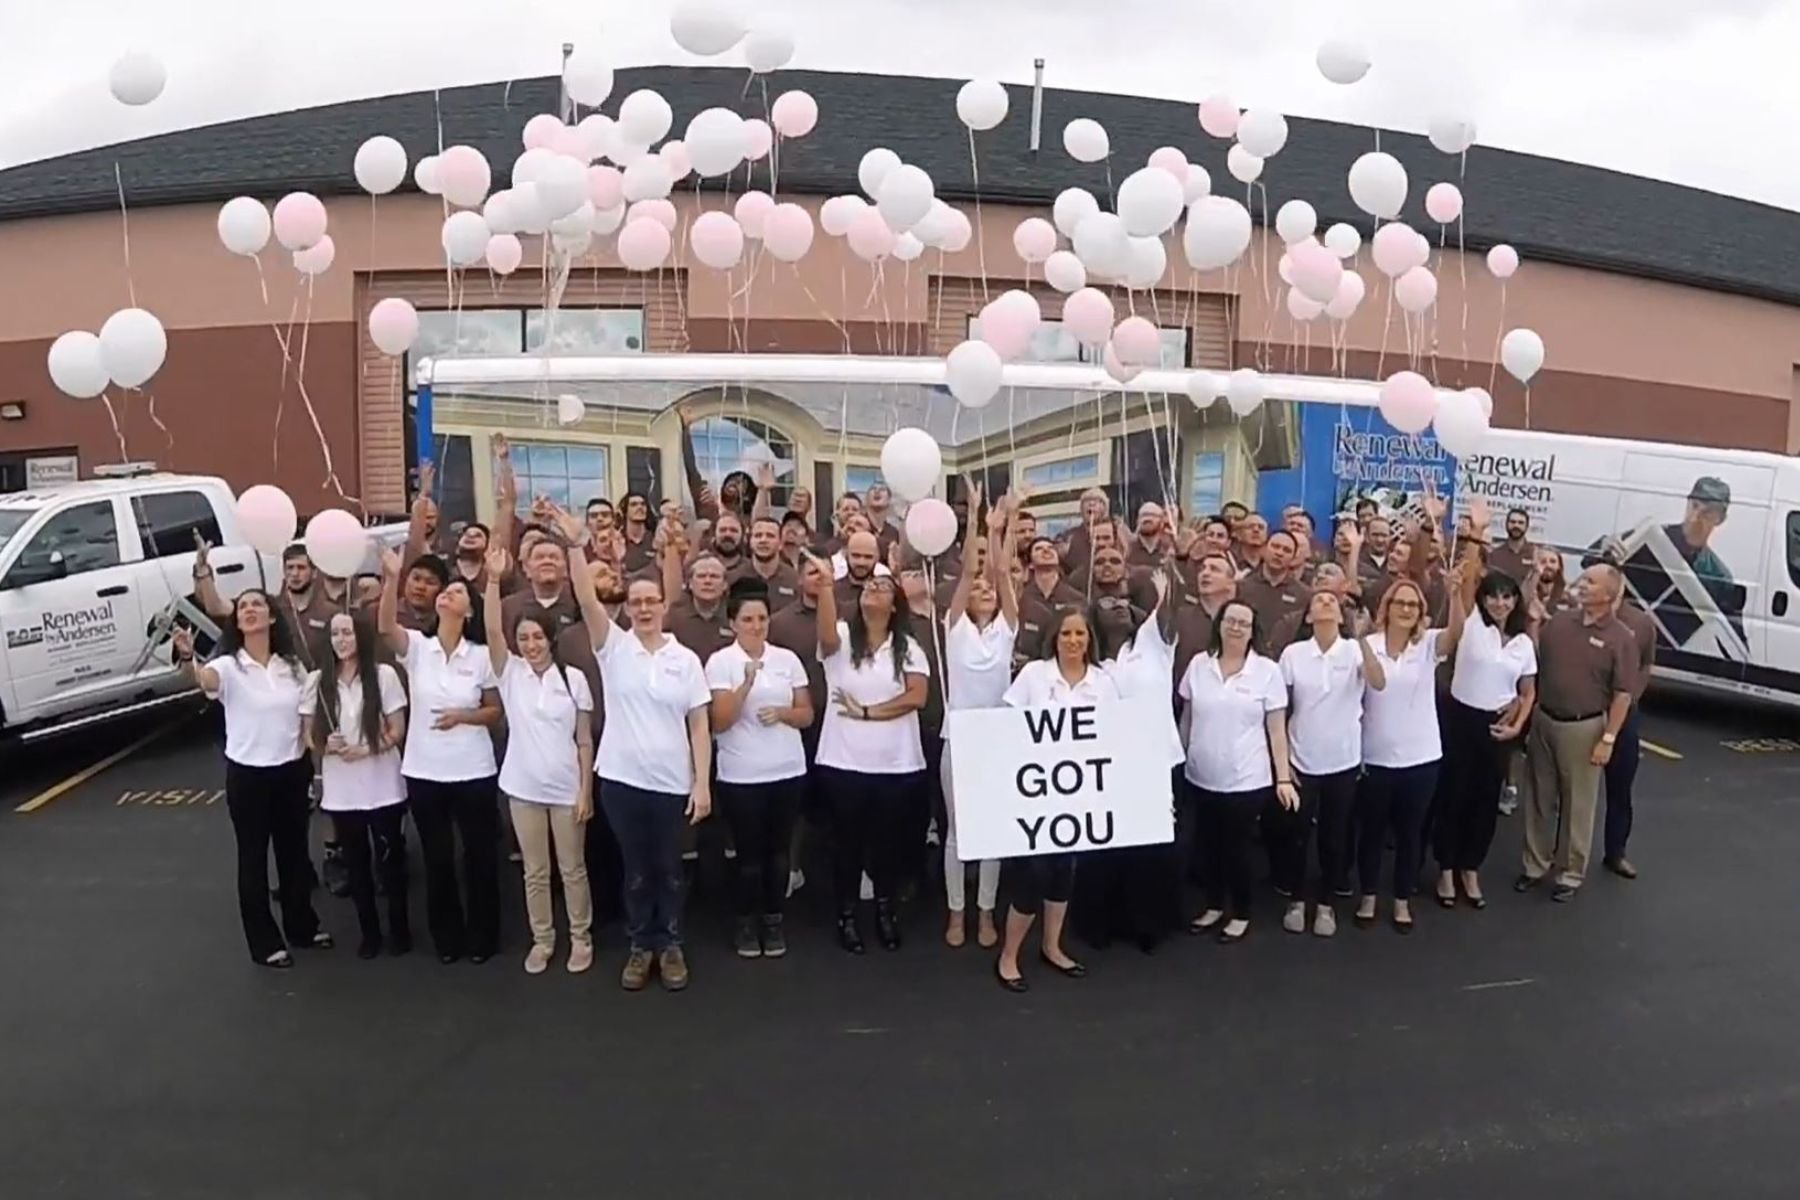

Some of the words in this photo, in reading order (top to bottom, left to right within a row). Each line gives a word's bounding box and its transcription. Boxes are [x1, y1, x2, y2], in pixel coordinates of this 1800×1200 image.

[1459, 454, 1555, 481] enewal
[42, 600, 113, 631] Renewal
[58, 622, 117, 642] Andersen
[1024, 706, 1097, 743] WE
[1016, 758, 1112, 798] GOT
[1017, 811, 1114, 850] YOU
